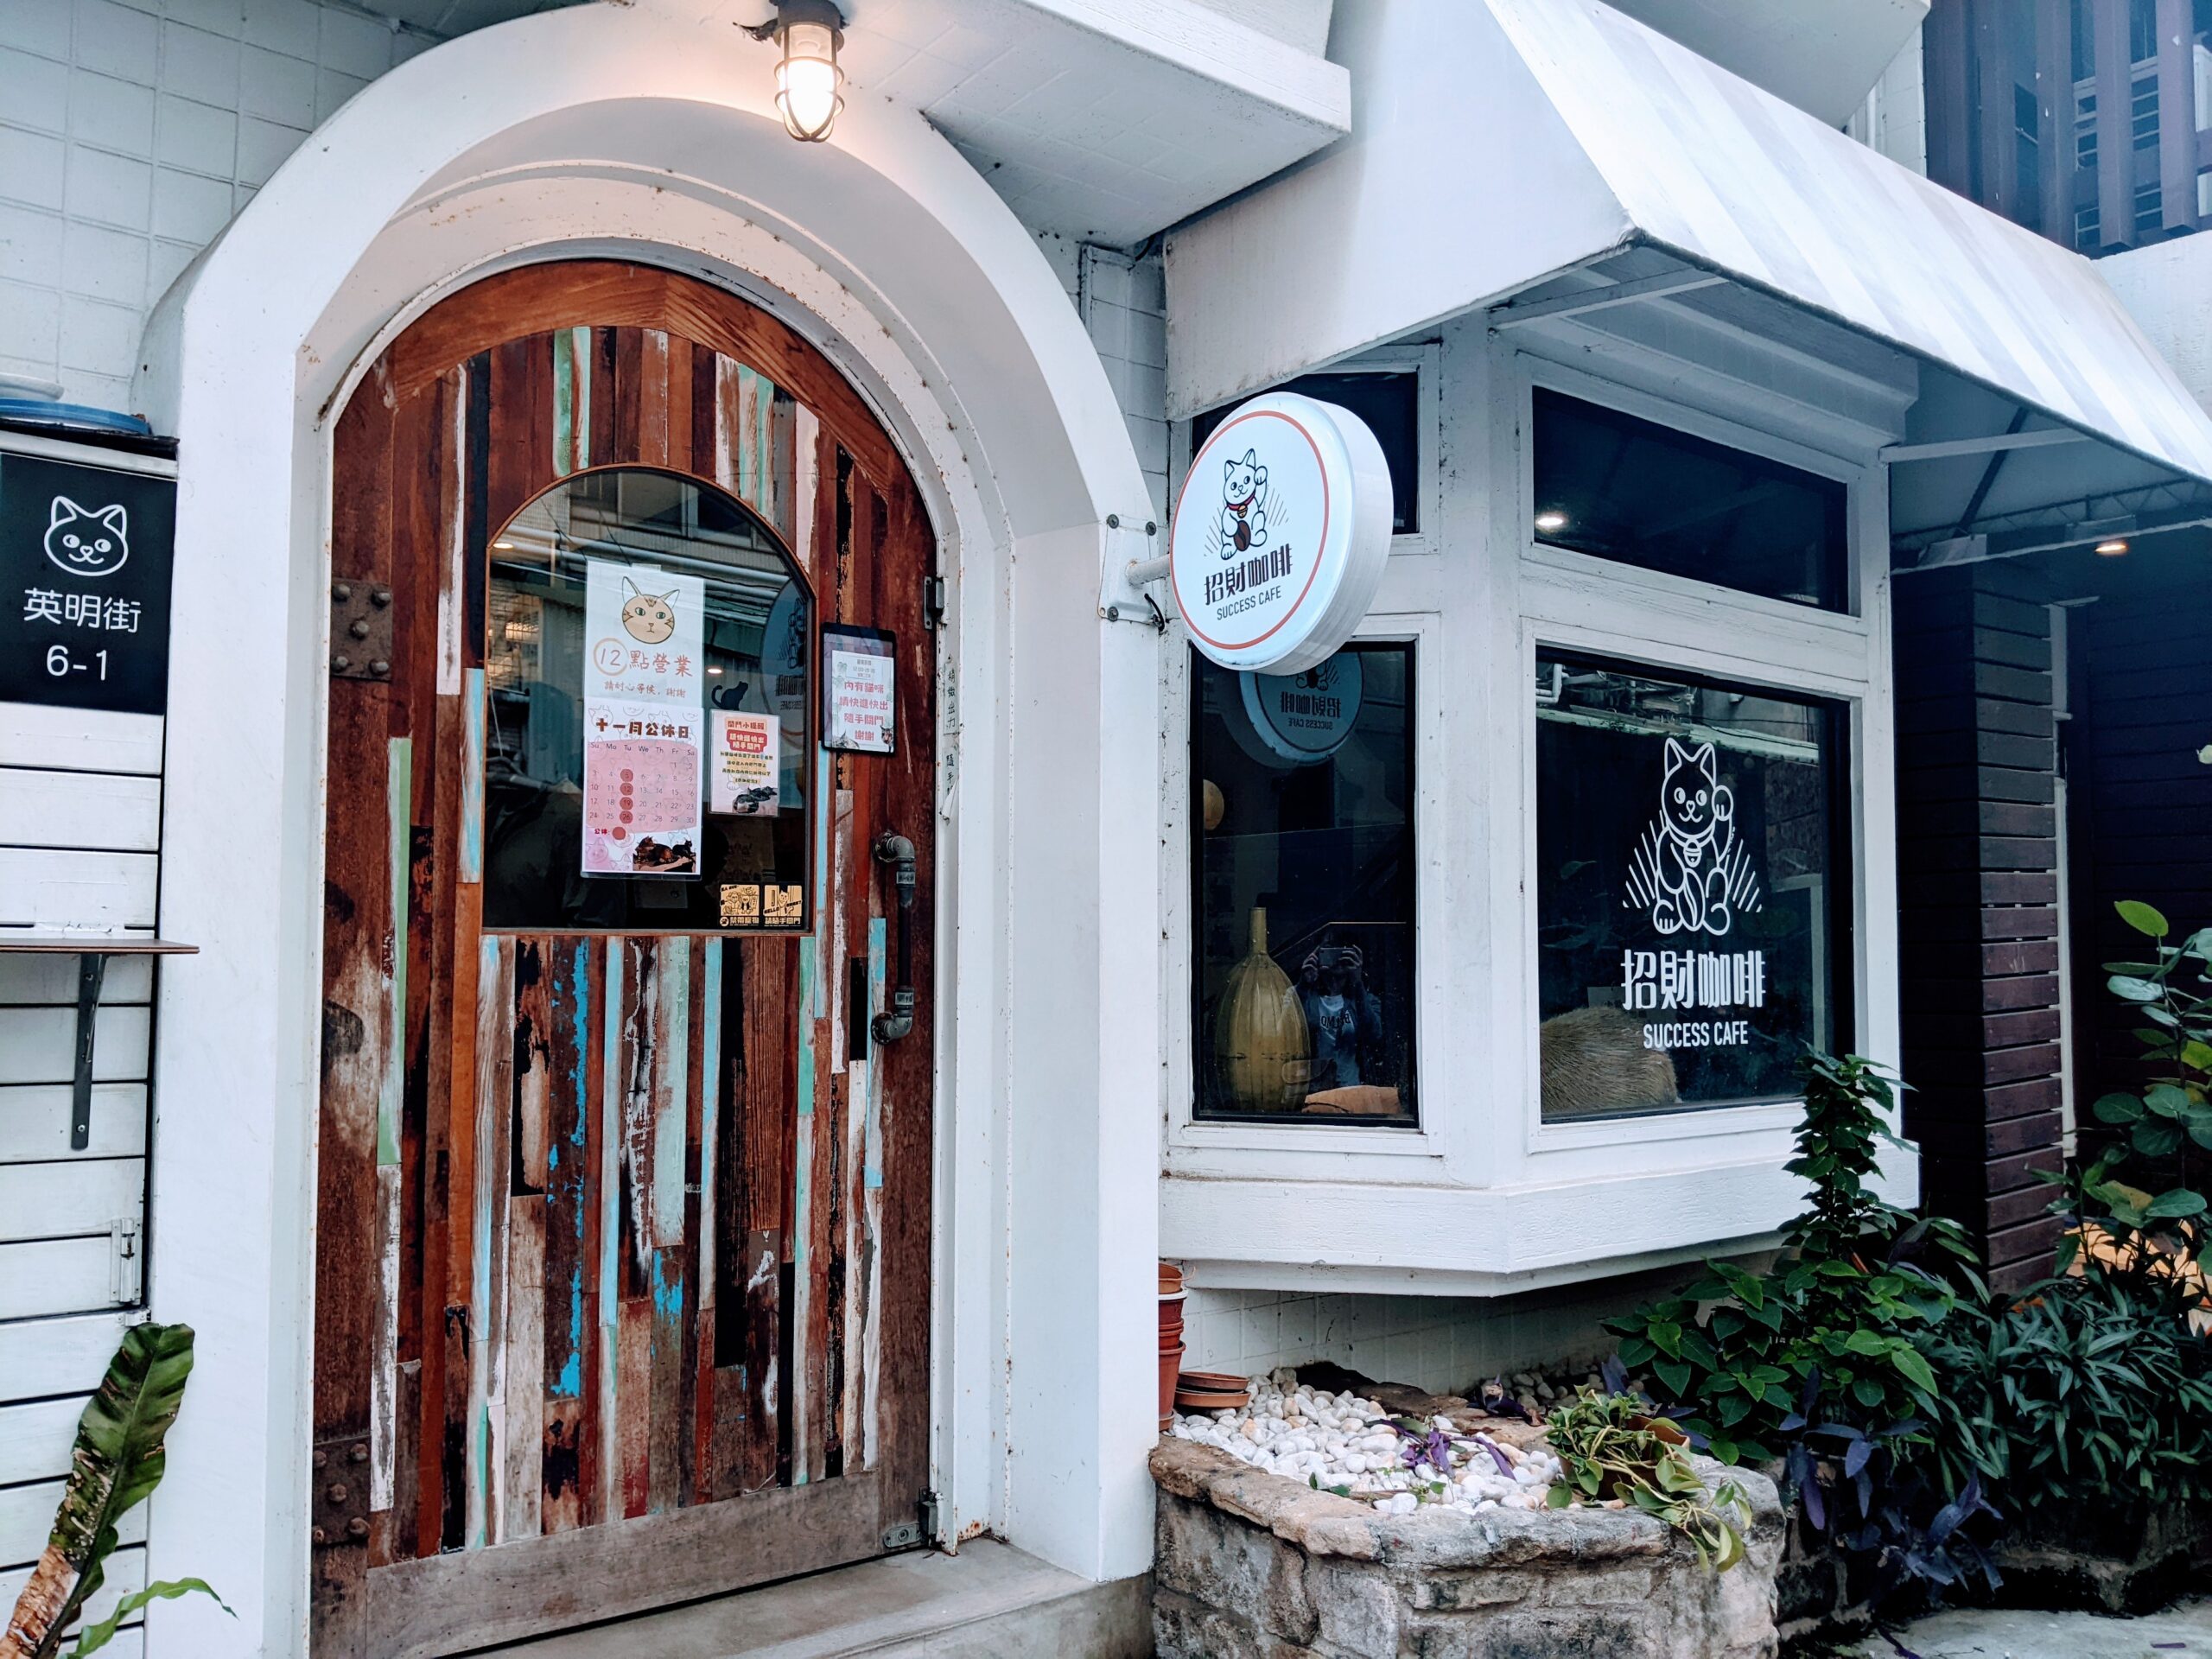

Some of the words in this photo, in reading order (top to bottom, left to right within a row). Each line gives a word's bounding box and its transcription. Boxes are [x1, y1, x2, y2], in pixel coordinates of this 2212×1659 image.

[1204, 543, 1293, 606] 招財咖啡
[23, 587, 142, 633] 英明街
[1217, 595, 1256, 620] SUCCESS
[1259, 585, 1281, 605] CAFE
[47, 645, 108, 681] 6-1
[596, 718, 690, 739] 十一月公休日
[1620, 949, 1766, 1010] 招財咖啡
[1643, 1021, 1710, 1049] SUCCESS
[1713, 1020, 1749, 1046] CAFE
